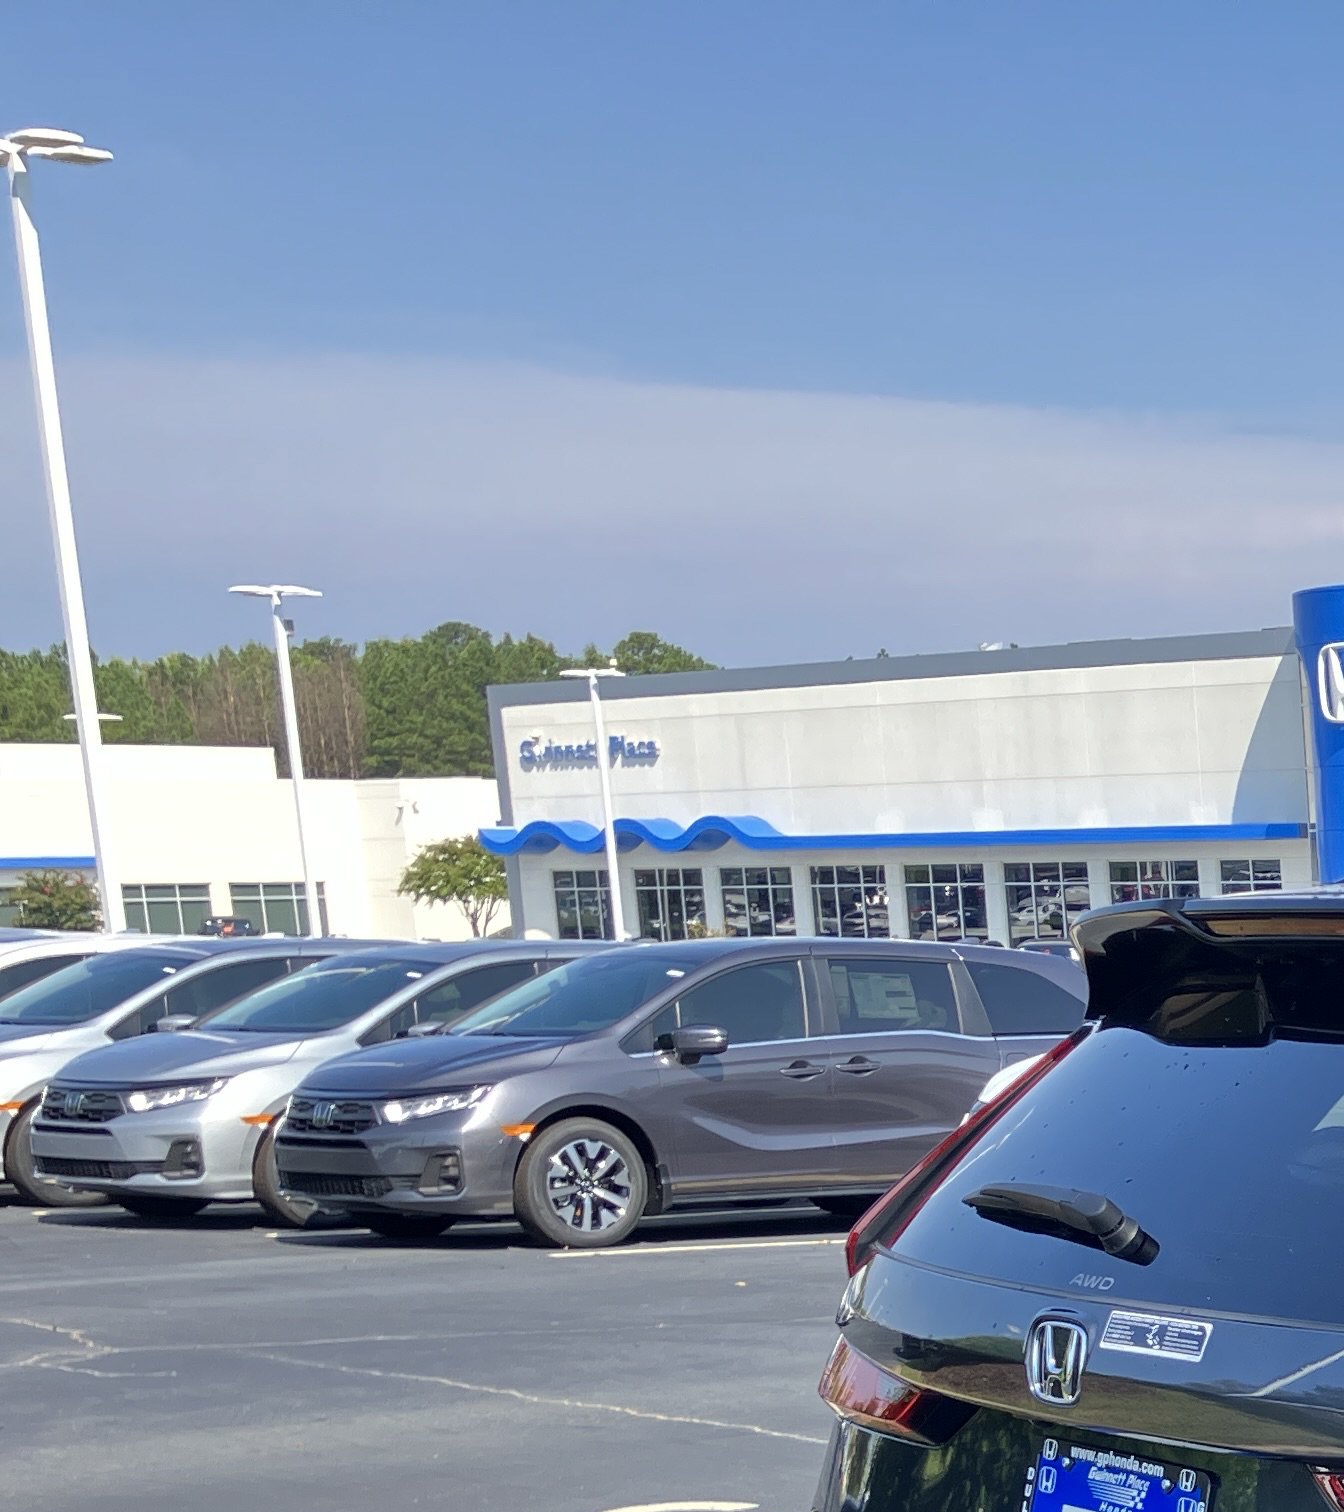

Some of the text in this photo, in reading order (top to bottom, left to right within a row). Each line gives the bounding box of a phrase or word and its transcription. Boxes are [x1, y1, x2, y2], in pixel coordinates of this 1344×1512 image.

[1069, 1273, 1115, 1290] AWD
[1071, 1446, 1165, 1477] www.gphonda.com
[1088, 1466, 1151, 1492] Gwinnett Place
